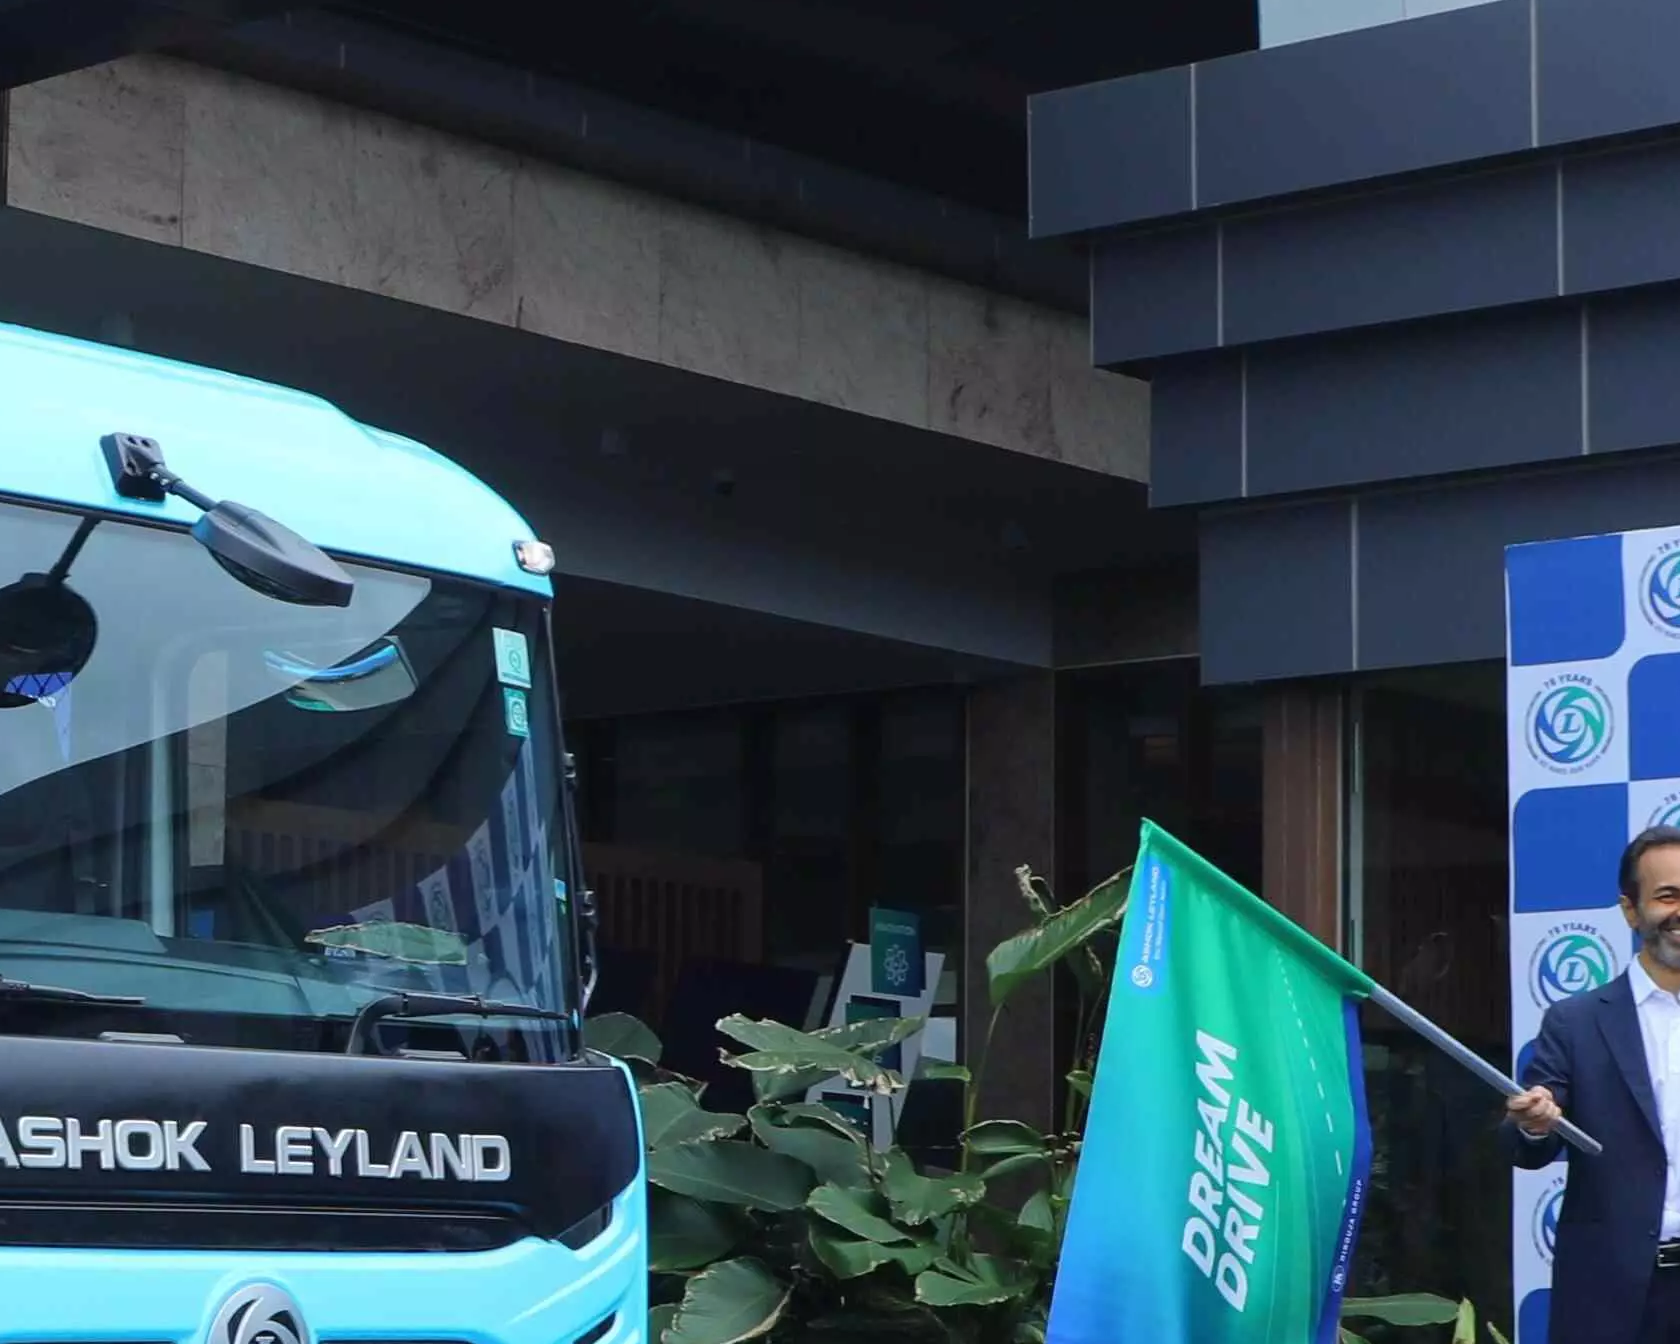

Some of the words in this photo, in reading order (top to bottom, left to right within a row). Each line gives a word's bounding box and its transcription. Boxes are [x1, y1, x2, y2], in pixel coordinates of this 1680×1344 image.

[1559, 674, 1592, 687] YEARS
[1563, 922, 1597, 935] YEARS
[239, 1123, 511, 1182] LEYLAND
[1181, 1028, 1238, 1280] DREAM
[1215, 1099, 1275, 1313] DRIVE
